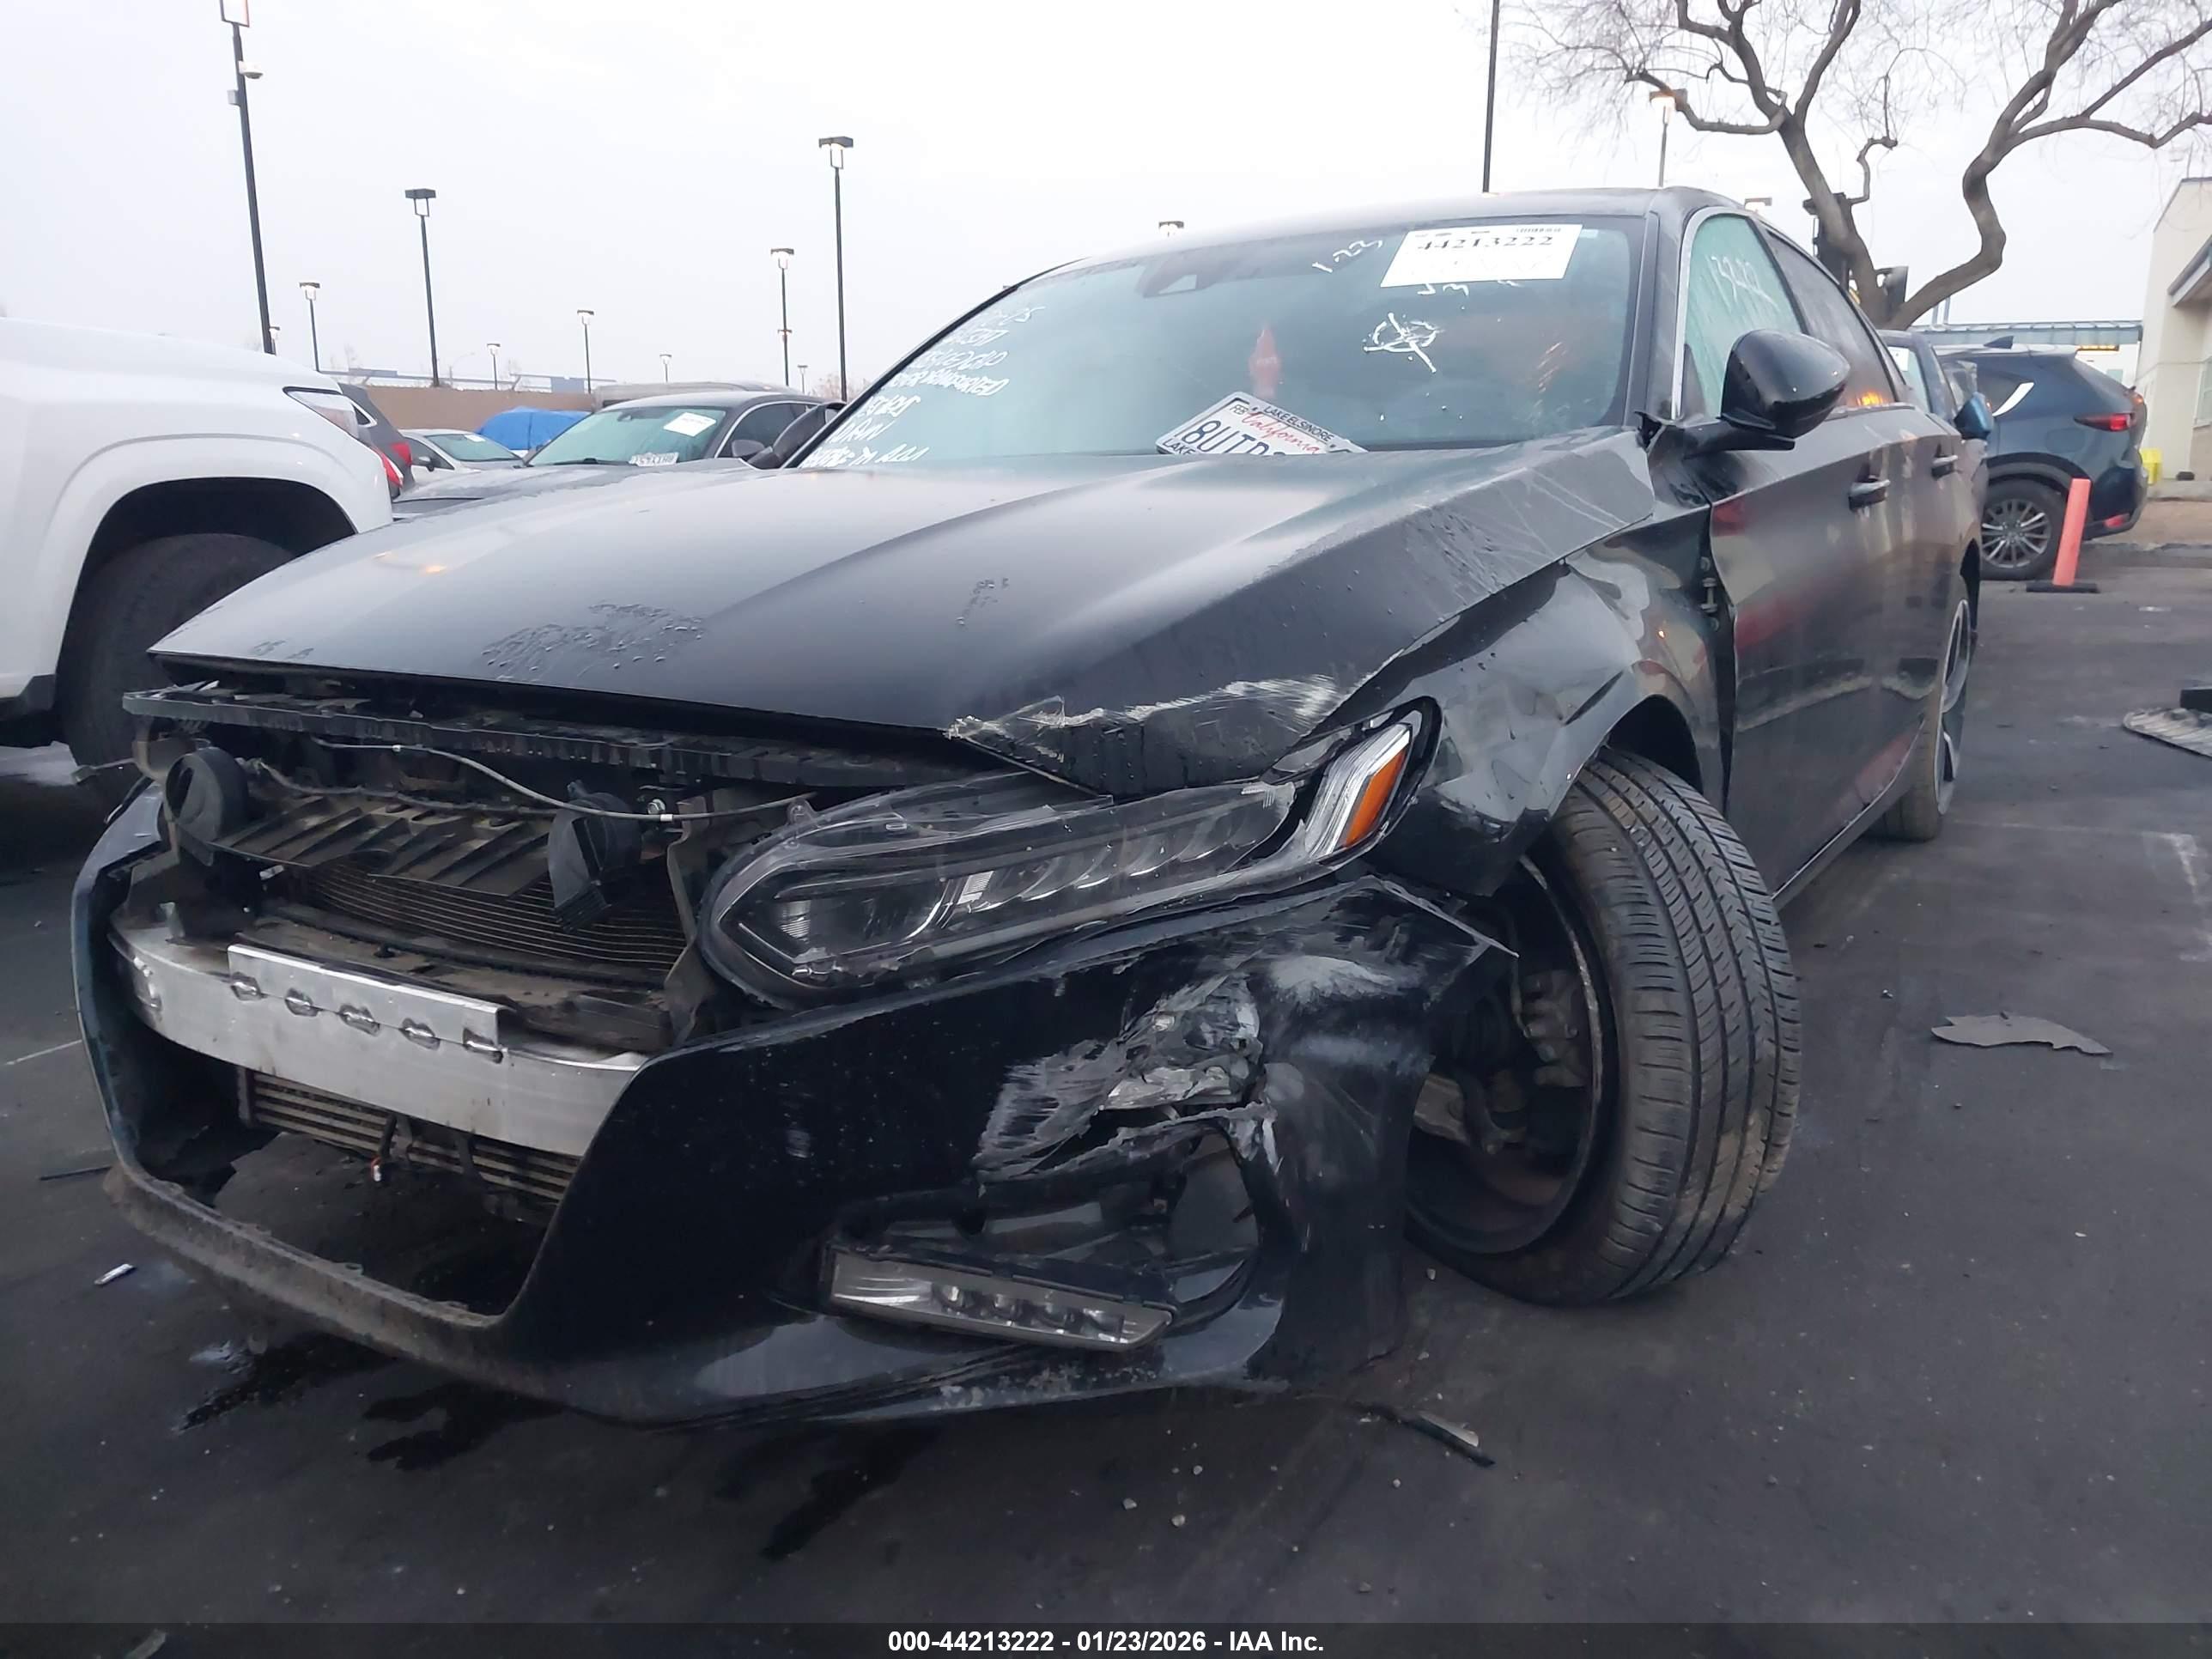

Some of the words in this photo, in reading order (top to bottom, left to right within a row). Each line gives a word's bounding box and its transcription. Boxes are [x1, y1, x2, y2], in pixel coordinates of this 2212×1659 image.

[1418, 234, 1554, 251] 44213222
[1242, 410, 1321, 454] California
[1263, 405, 1289, 421] LAKE
[1287, 416, 1335, 442] ELSINORE
